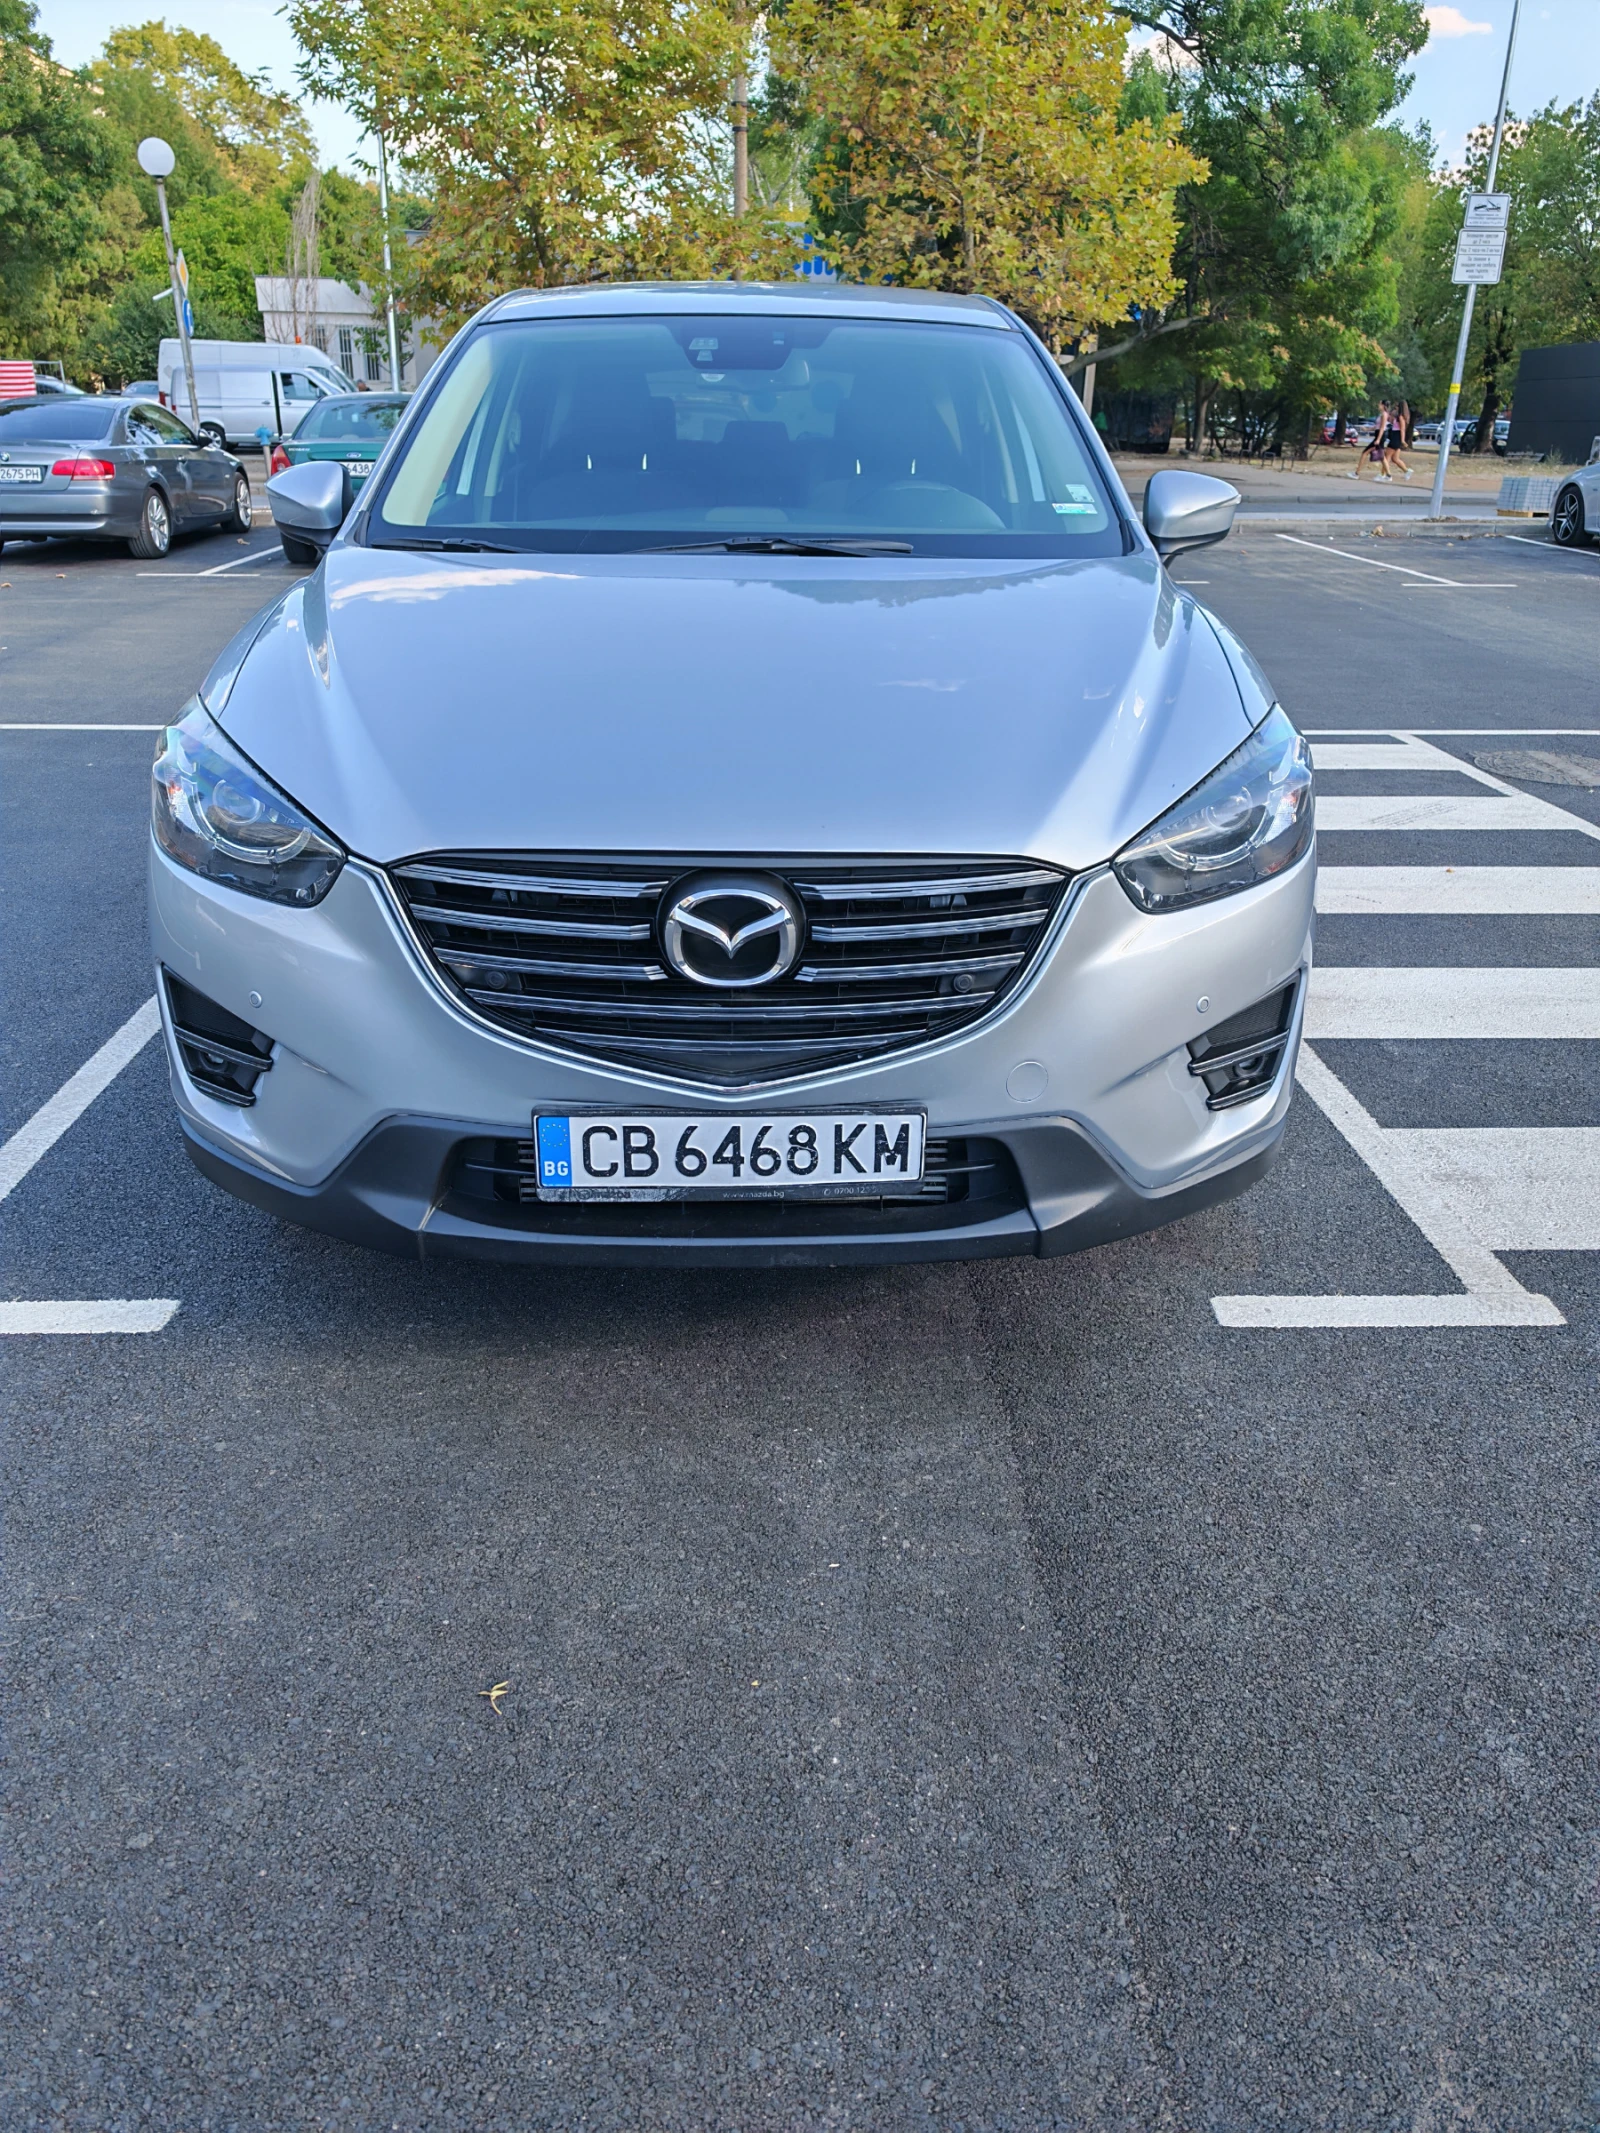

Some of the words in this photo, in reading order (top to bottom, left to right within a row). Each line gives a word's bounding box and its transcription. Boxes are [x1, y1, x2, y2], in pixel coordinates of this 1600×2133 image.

[582, 1123, 660, 1178] CB
[675, 1123, 818, 1178] 6468
[834, 1123, 910, 1175] KM
[544, 1161, 569, 1177] BG
